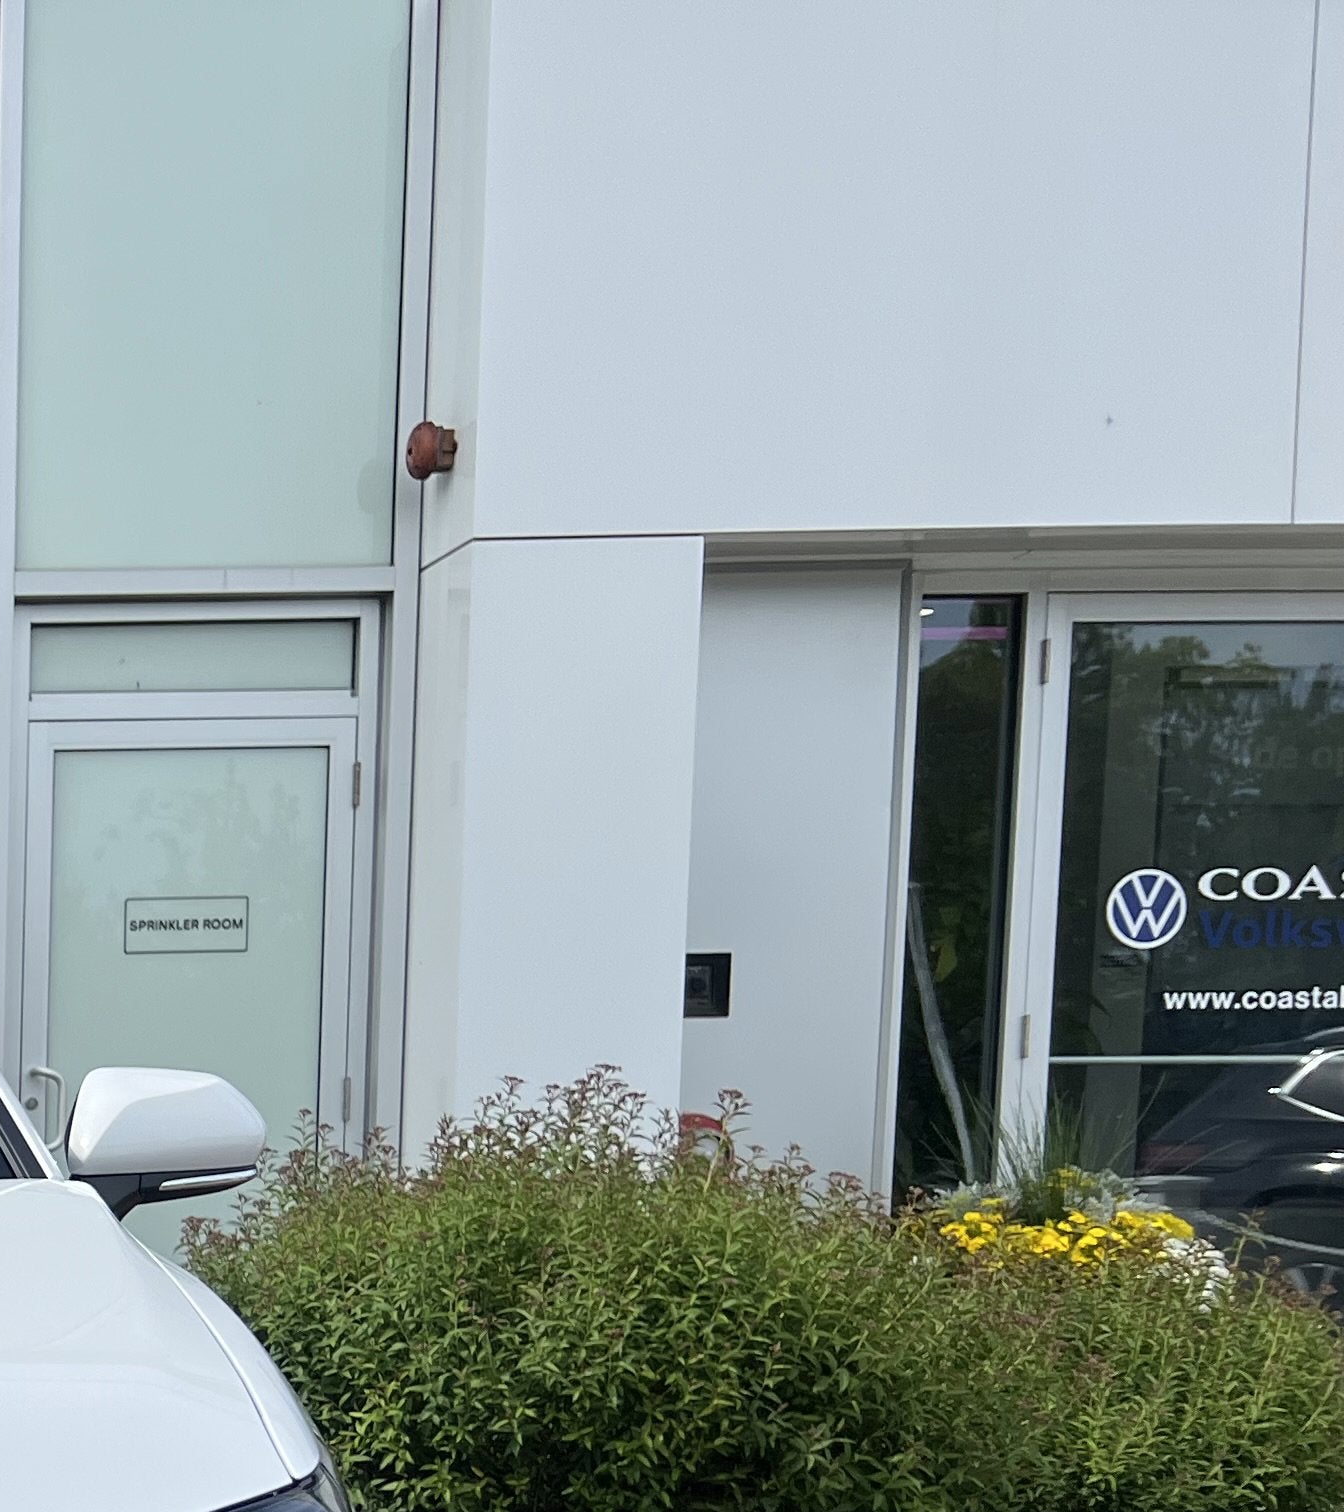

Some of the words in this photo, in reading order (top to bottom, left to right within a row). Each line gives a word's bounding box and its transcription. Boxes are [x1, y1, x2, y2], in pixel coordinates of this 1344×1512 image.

[1197, 864, 1344, 901] COA
[130, 919, 199, 932] SPRINKLER
[203, 918, 243, 931] ROOM
[1199, 907, 1344, 949] Volks
